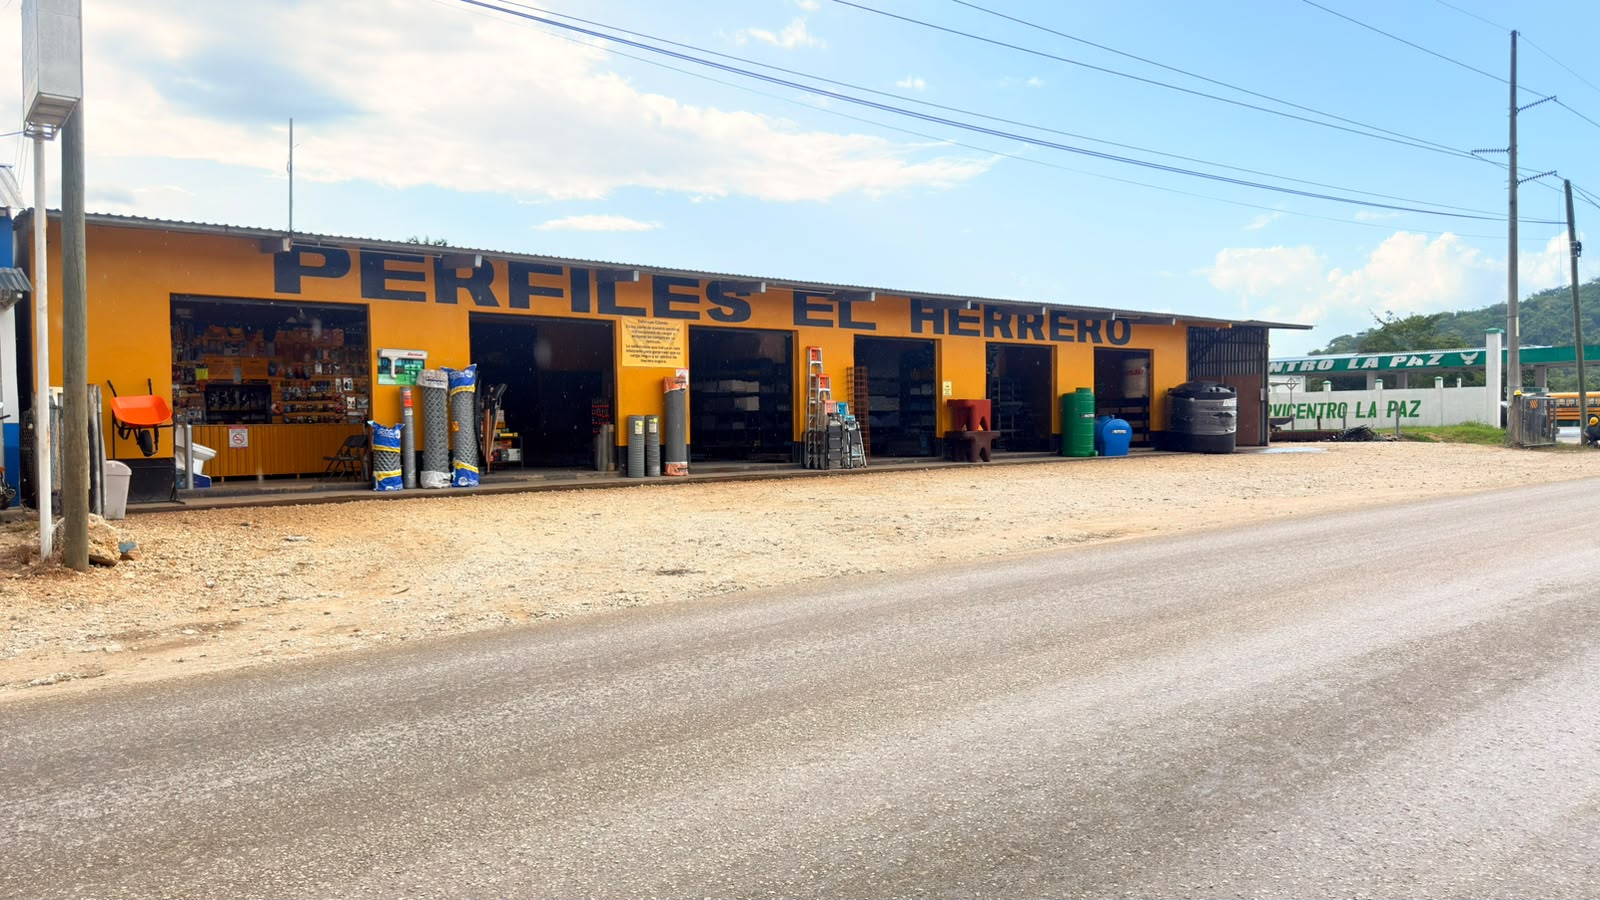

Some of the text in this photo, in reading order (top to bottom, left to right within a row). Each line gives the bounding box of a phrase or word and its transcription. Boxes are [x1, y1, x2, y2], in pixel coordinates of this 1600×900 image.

[274, 243, 1131, 346] PERFILES EL HERRERO
[1347, 357, 1379, 369] LA
[1389, 353, 1445, 367] PAZ
[1355, 401, 1377, 418] LA
[1386, 399, 1422, 418] PAZ
